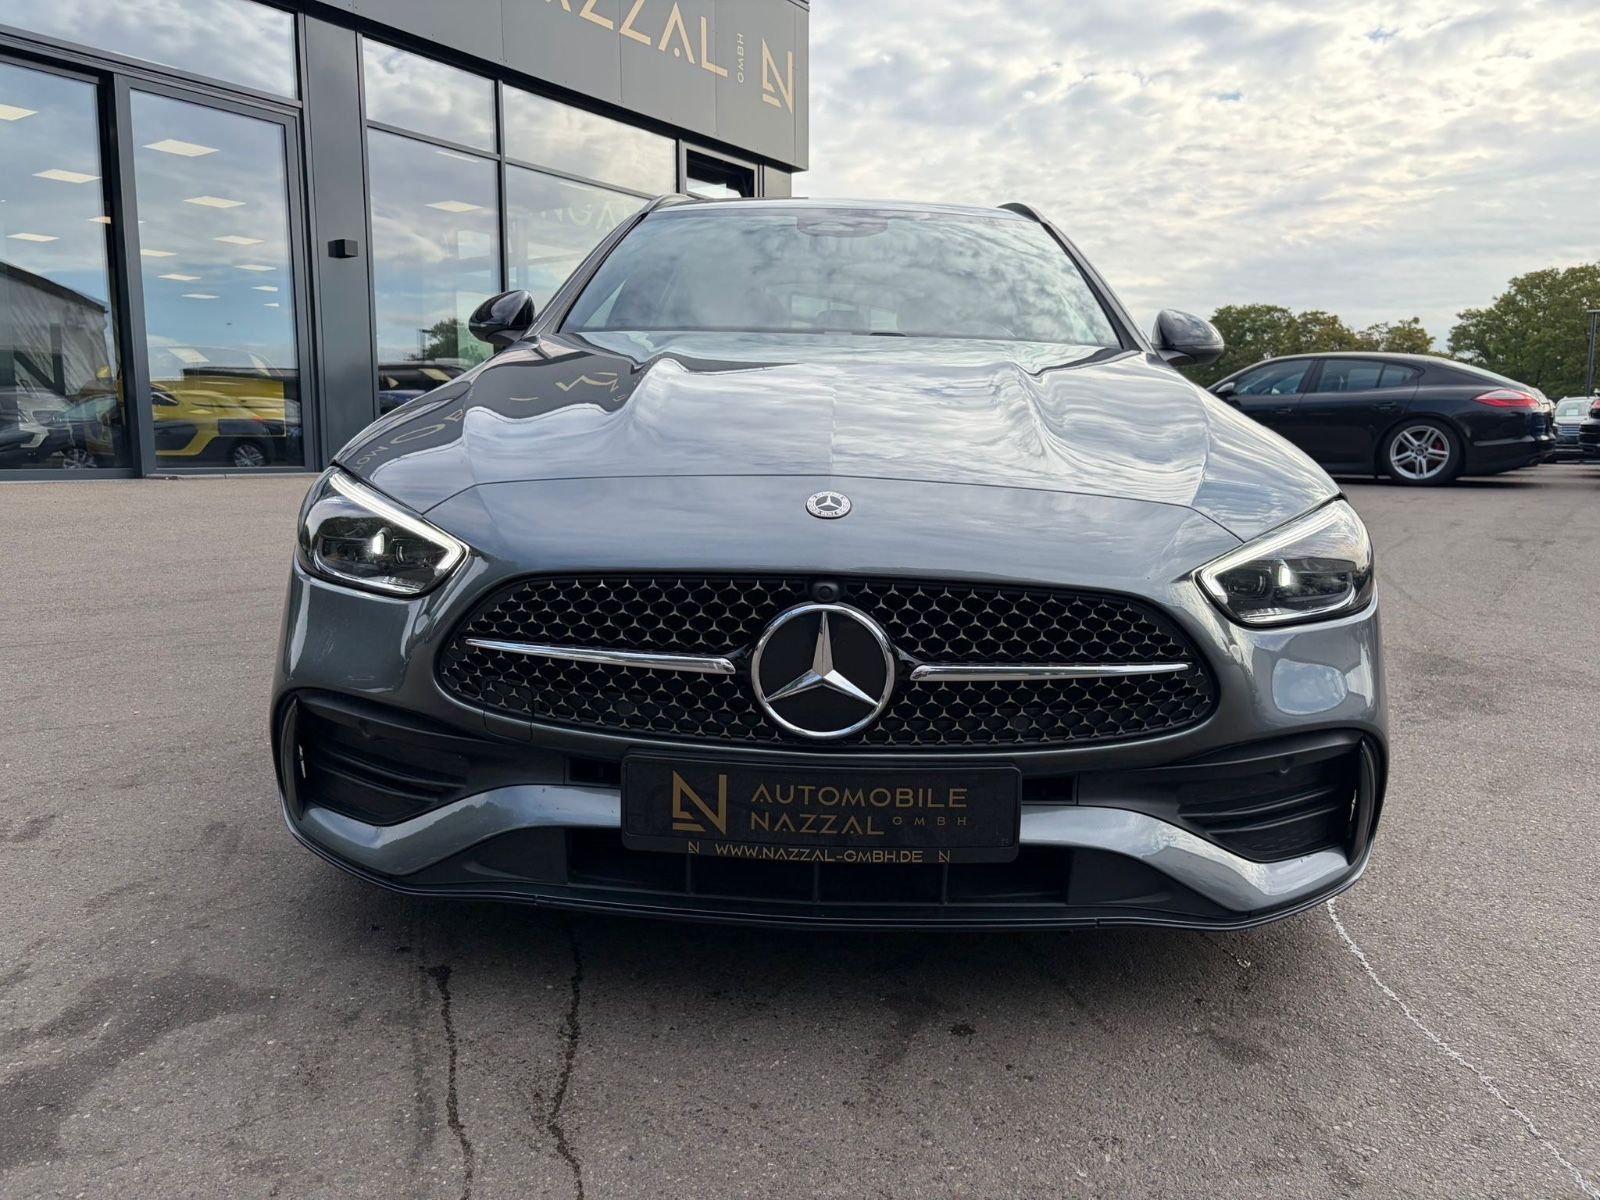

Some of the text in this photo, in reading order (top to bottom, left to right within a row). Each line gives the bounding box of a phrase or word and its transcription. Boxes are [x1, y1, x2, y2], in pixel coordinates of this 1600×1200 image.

[751, 783, 968, 808] AUTOMOBILE
[751, 811, 885, 836] NAZZAL
[715, 843, 924, 864] WWW.NAZZAL-GMBH.DE
